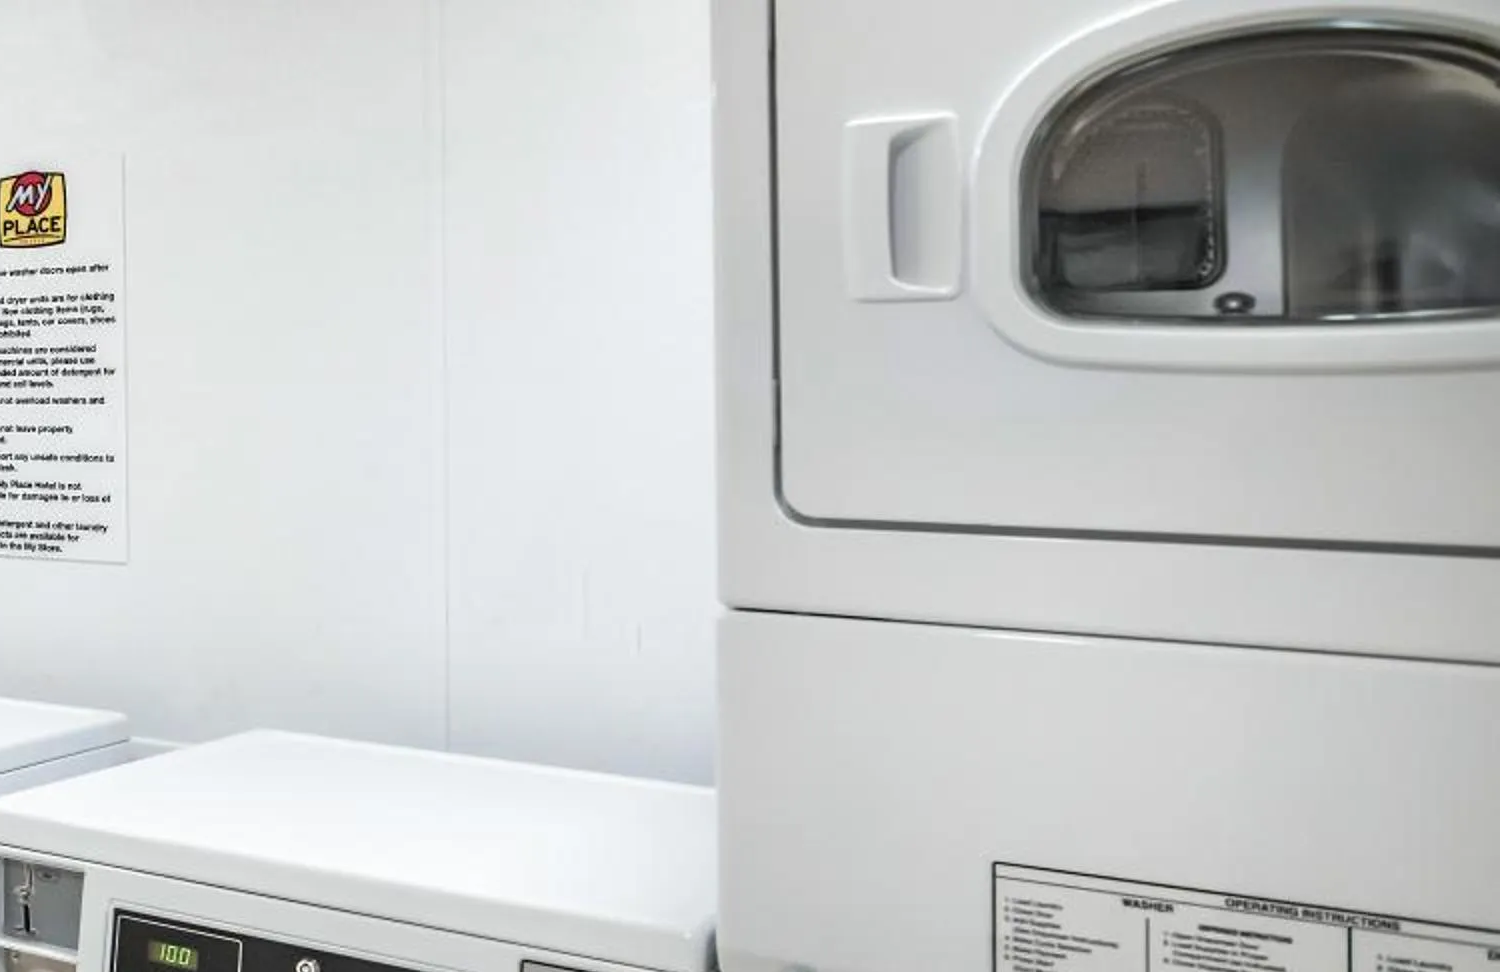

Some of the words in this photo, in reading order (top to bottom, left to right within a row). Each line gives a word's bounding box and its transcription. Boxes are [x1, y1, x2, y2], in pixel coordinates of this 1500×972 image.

[3, 216, 62, 236] PLACE
[1121, 898, 1175, 913] WASHER
[1224, 897, 1299, 918] OPERATING
[1301, 908, 1401, 932] INSTRUCTIONS
